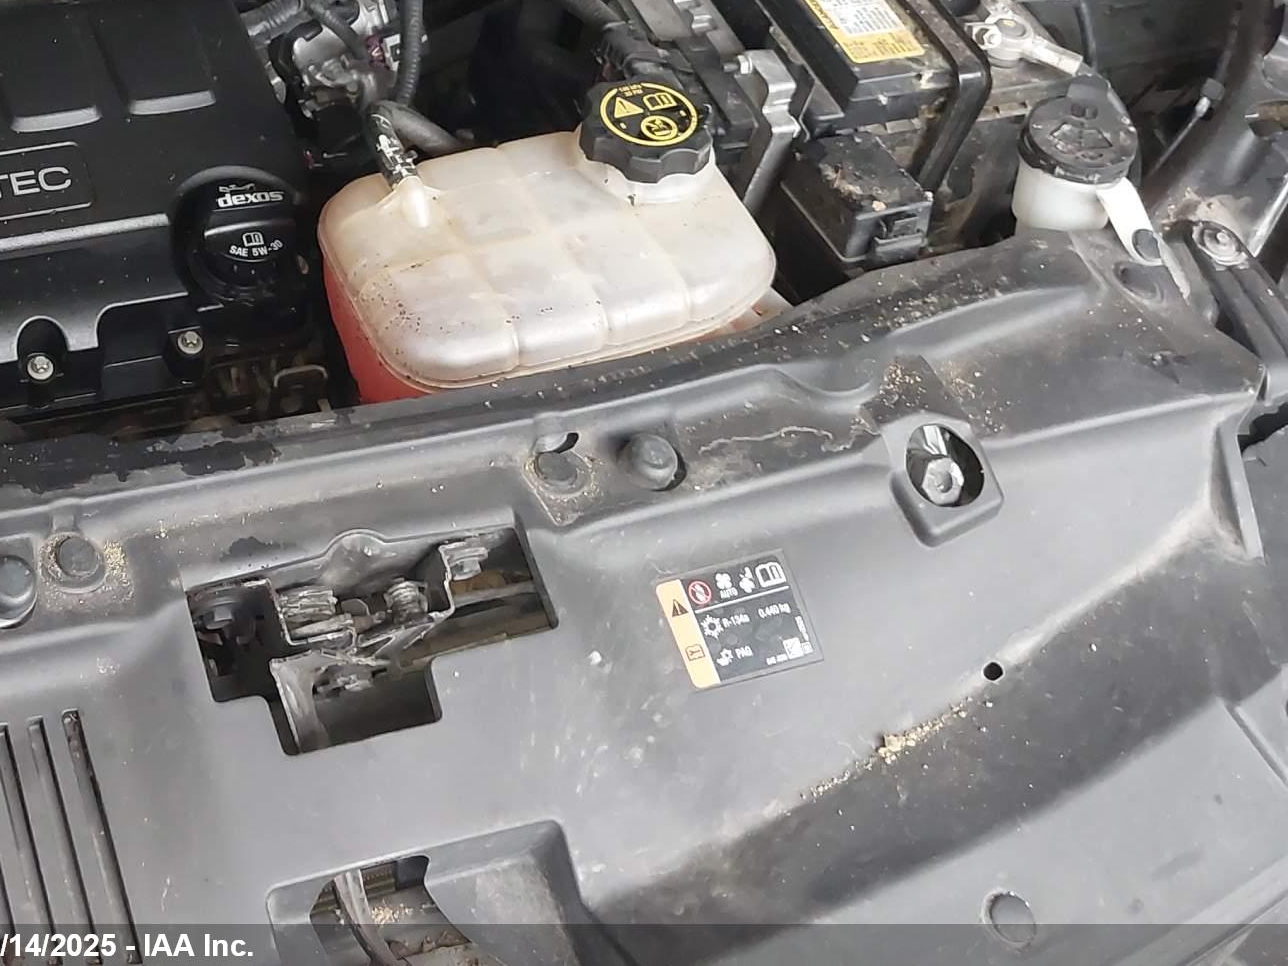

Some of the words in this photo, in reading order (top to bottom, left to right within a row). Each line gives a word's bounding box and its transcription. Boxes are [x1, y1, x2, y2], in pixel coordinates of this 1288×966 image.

[217, 191, 285, 208] dexos
[229, 245, 249, 257] SAE
[251, 239, 284, 256] 5W-30
[719, 586, 739, 599] AUTO
